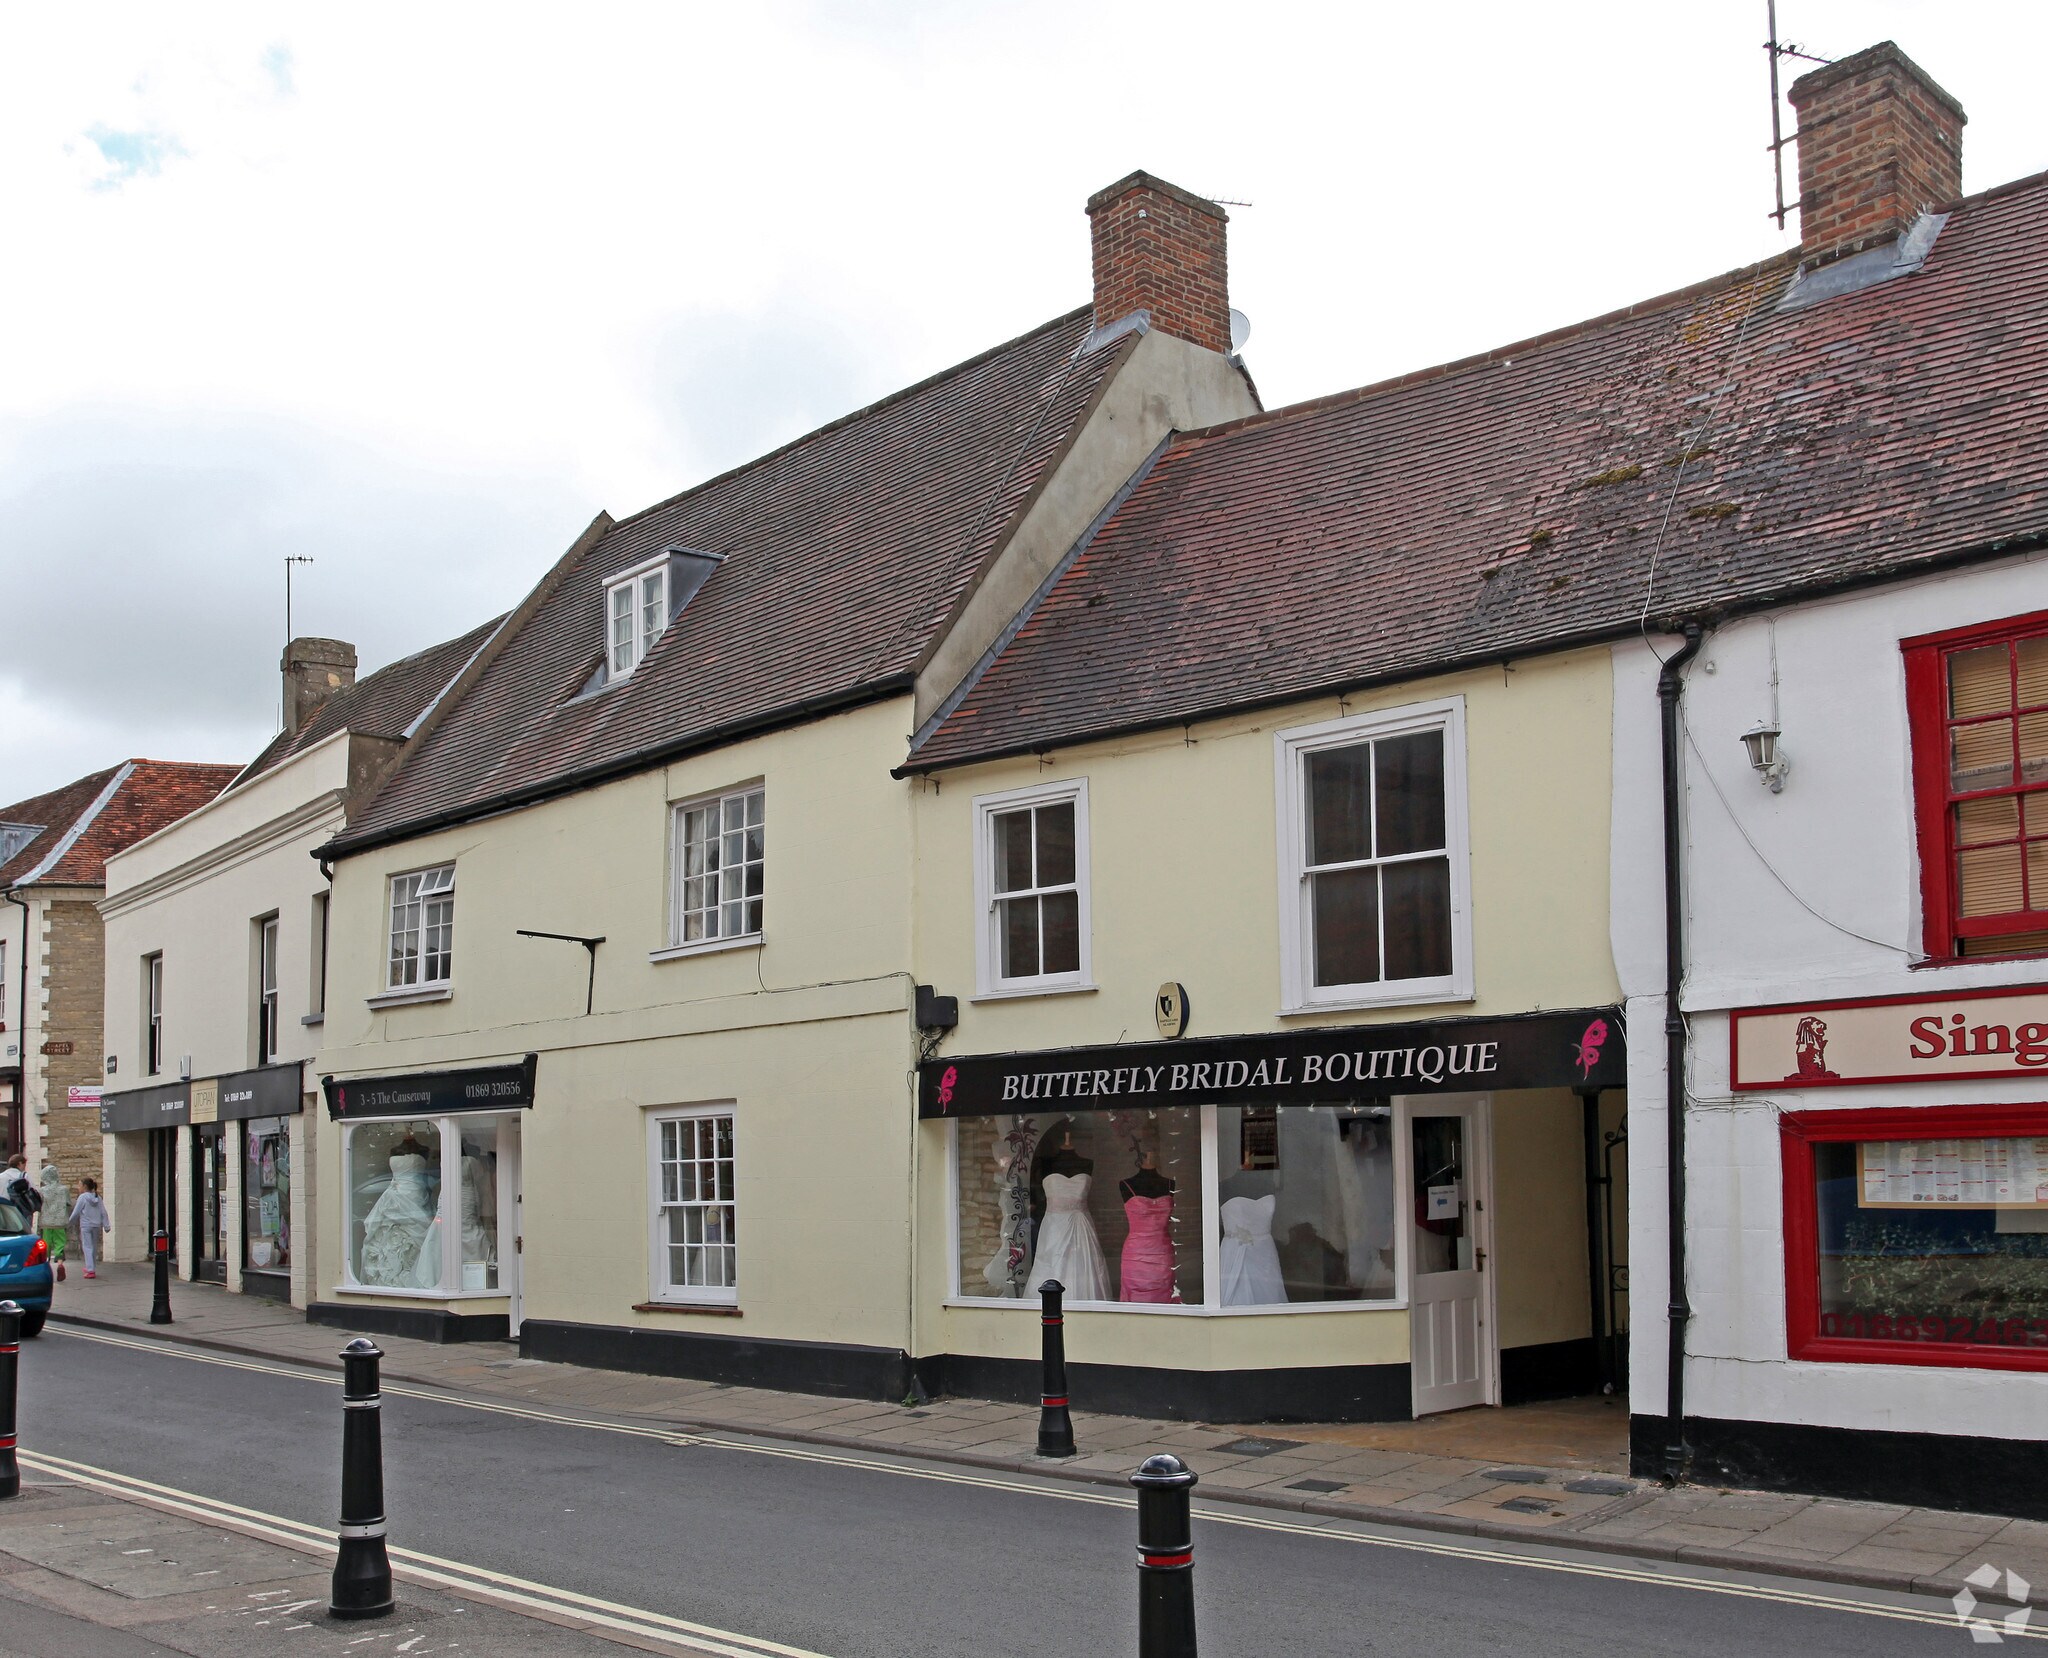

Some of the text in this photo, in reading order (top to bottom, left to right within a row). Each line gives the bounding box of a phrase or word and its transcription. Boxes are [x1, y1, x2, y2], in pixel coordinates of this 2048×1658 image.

[1910, 1013, 2048, 1066] Sing
[1001, 1041, 1498, 1100] BUTTERFLY BRIDAL BOUTIQUE
[360, 1093, 365, 1106] 3
[371, 1092, 376, 1105] 5
[376, 1091, 391, 1104] The
[391, 1090, 431, 1105] Causeway
[465, 1081, 521, 1098] 01869 320556
